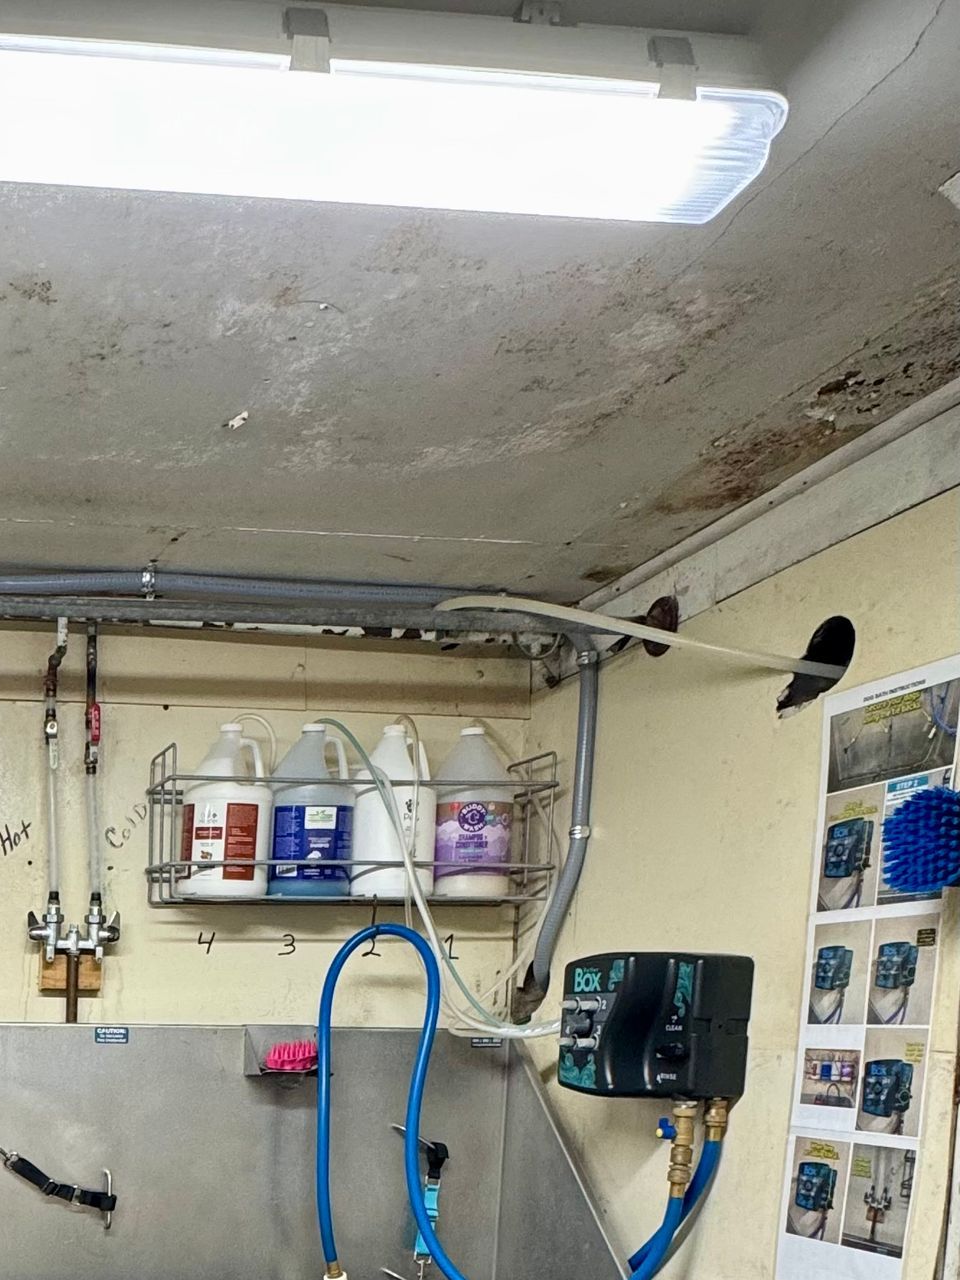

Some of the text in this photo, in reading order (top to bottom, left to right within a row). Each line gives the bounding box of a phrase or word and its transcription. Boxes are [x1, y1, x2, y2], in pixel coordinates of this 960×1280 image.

[896, 781, 913, 790] STEP
[461, 803, 487, 815] BUDDY
[463, 822, 484, 832] WASH
[458, 833, 484, 841] SHAMPOO
[197, 932, 216, 955] 4
[278, 933, 296, 956] 3
[361, 936, 382, 958] 2
[443, 934, 459, 960] 1
[574, 967, 602, 993] BOX
[601, 1000, 607, 1009] 2
